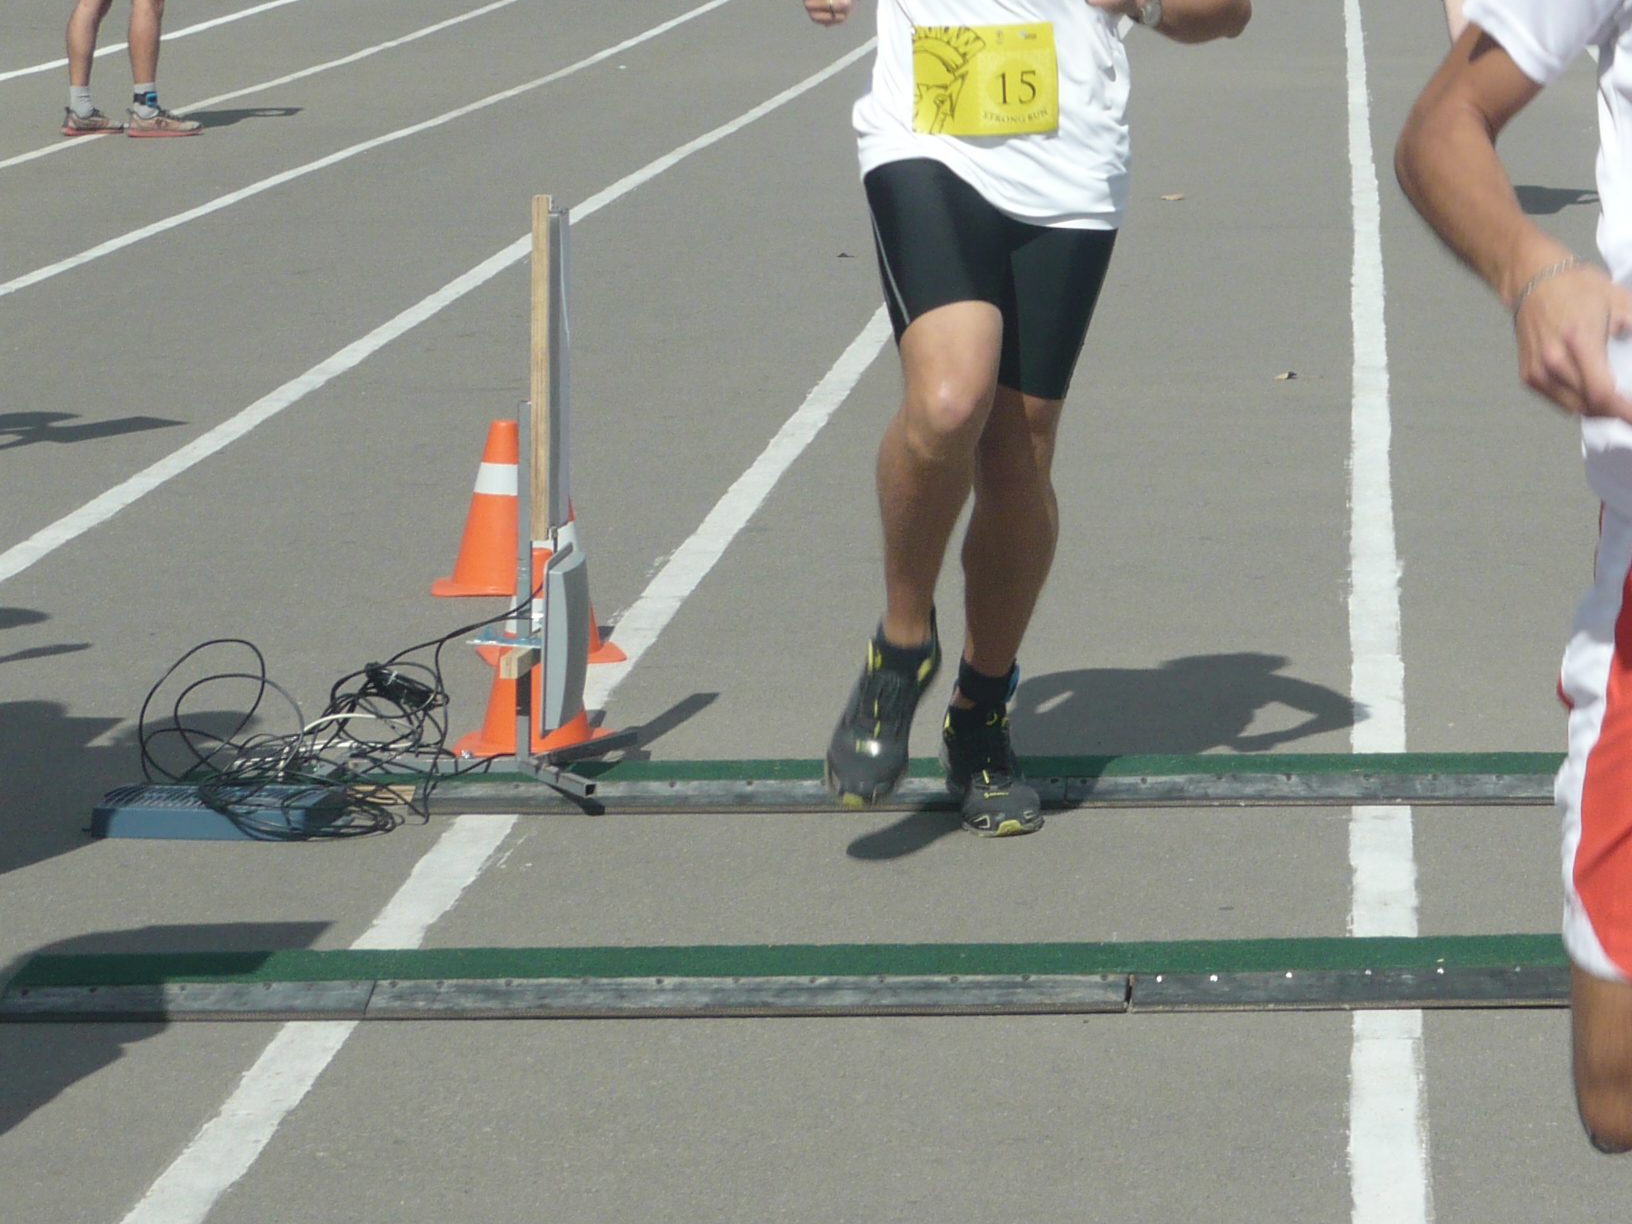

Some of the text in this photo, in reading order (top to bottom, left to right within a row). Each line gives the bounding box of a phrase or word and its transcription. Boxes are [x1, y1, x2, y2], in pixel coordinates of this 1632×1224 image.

[998, 70, 1037, 106] 15
[983, 108, 1049, 123] STRONG RUN
